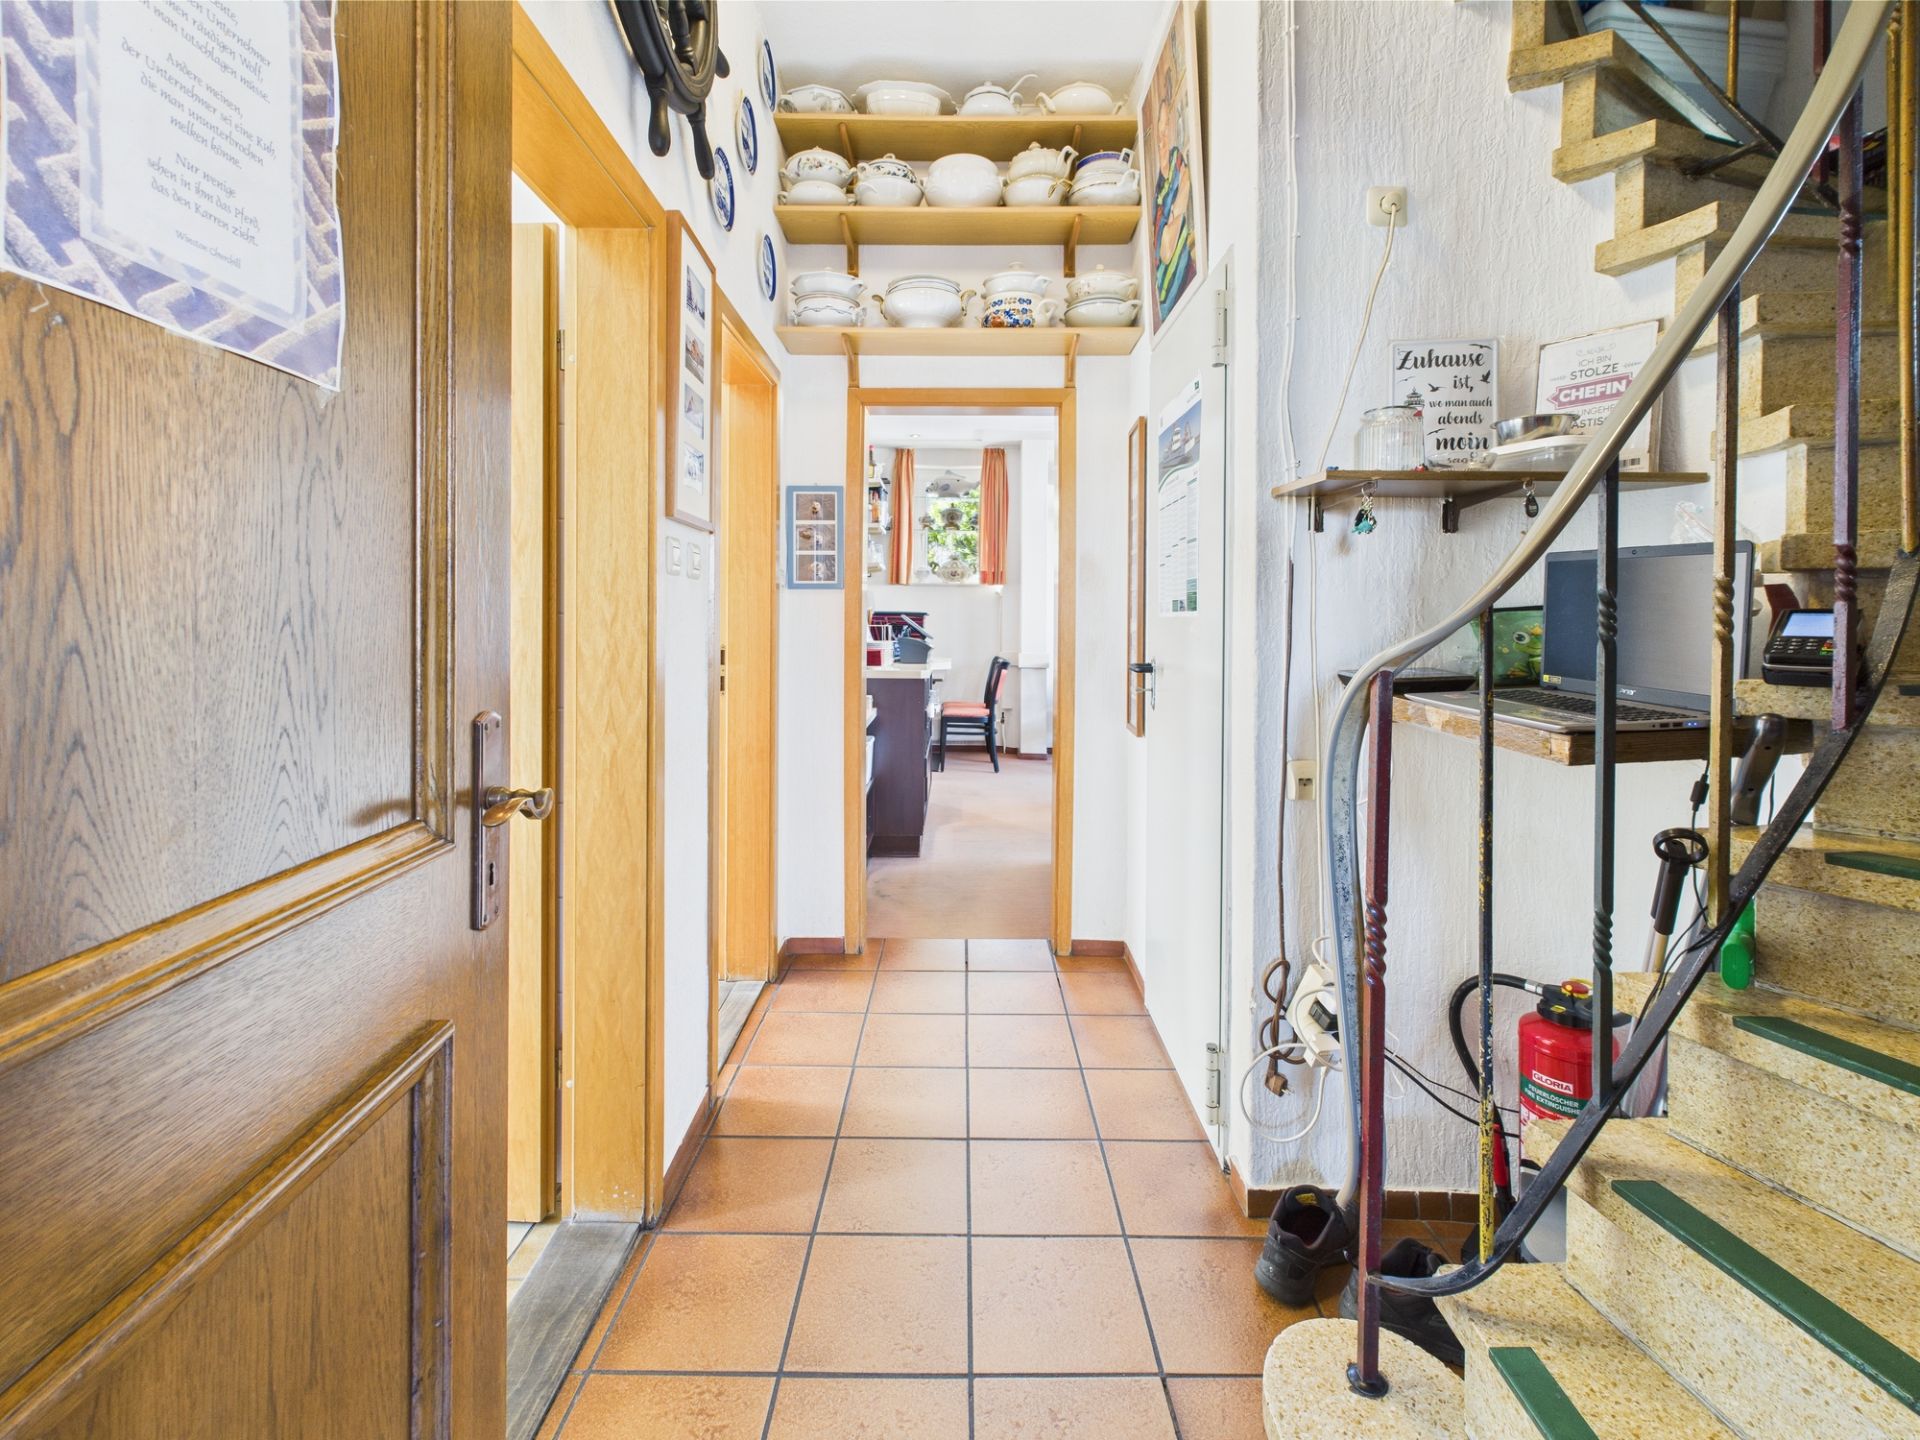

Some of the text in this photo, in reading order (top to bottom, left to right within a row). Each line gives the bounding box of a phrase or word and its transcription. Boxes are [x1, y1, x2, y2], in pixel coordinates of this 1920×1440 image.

[153, 6, 178, 32] man
[181, 27, 238, 79] totschlagen
[207, 8, 271, 67] Unternehmer
[166, 52, 203, 87] Andere
[239, 53, 263, 83] Wolf,
[122, 36, 141, 59] der
[145, 55, 217, 115] Unternehmer
[234, 122, 254, 142] eine
[140, 71, 157, 93] die
[160, 88, 185, 112] man
[170, 115, 208, 148] melken
[147, 157, 177, 182] sehen
[181, 174, 191, 191] in
[194, 181, 213, 203] ihm
[216, 195, 231, 214] das
[176, 152, 237, 199] Nur wenige
[151, 176, 170, 198] das
[172, 188, 191, 210] den
[194, 202, 229, 231] Karren
[1396, 348, 1485, 370] Zuhause
[1569, 363, 1620, 381] STOLZE
[1578, 353, 1612, 368] ICH BIN
[1452, 376, 1475, 393] ist,
[1558, 379, 1628, 403] CHEFIN
[1429, 396, 1493, 408] wo man auch
[1437, 411, 1483, 425] abends
[1435, 431, 1490, 451] moin
[1533, 1072, 1572, 1092] GLORIA
[1536, 1094, 1581, 1114] EXTINGUISHE
